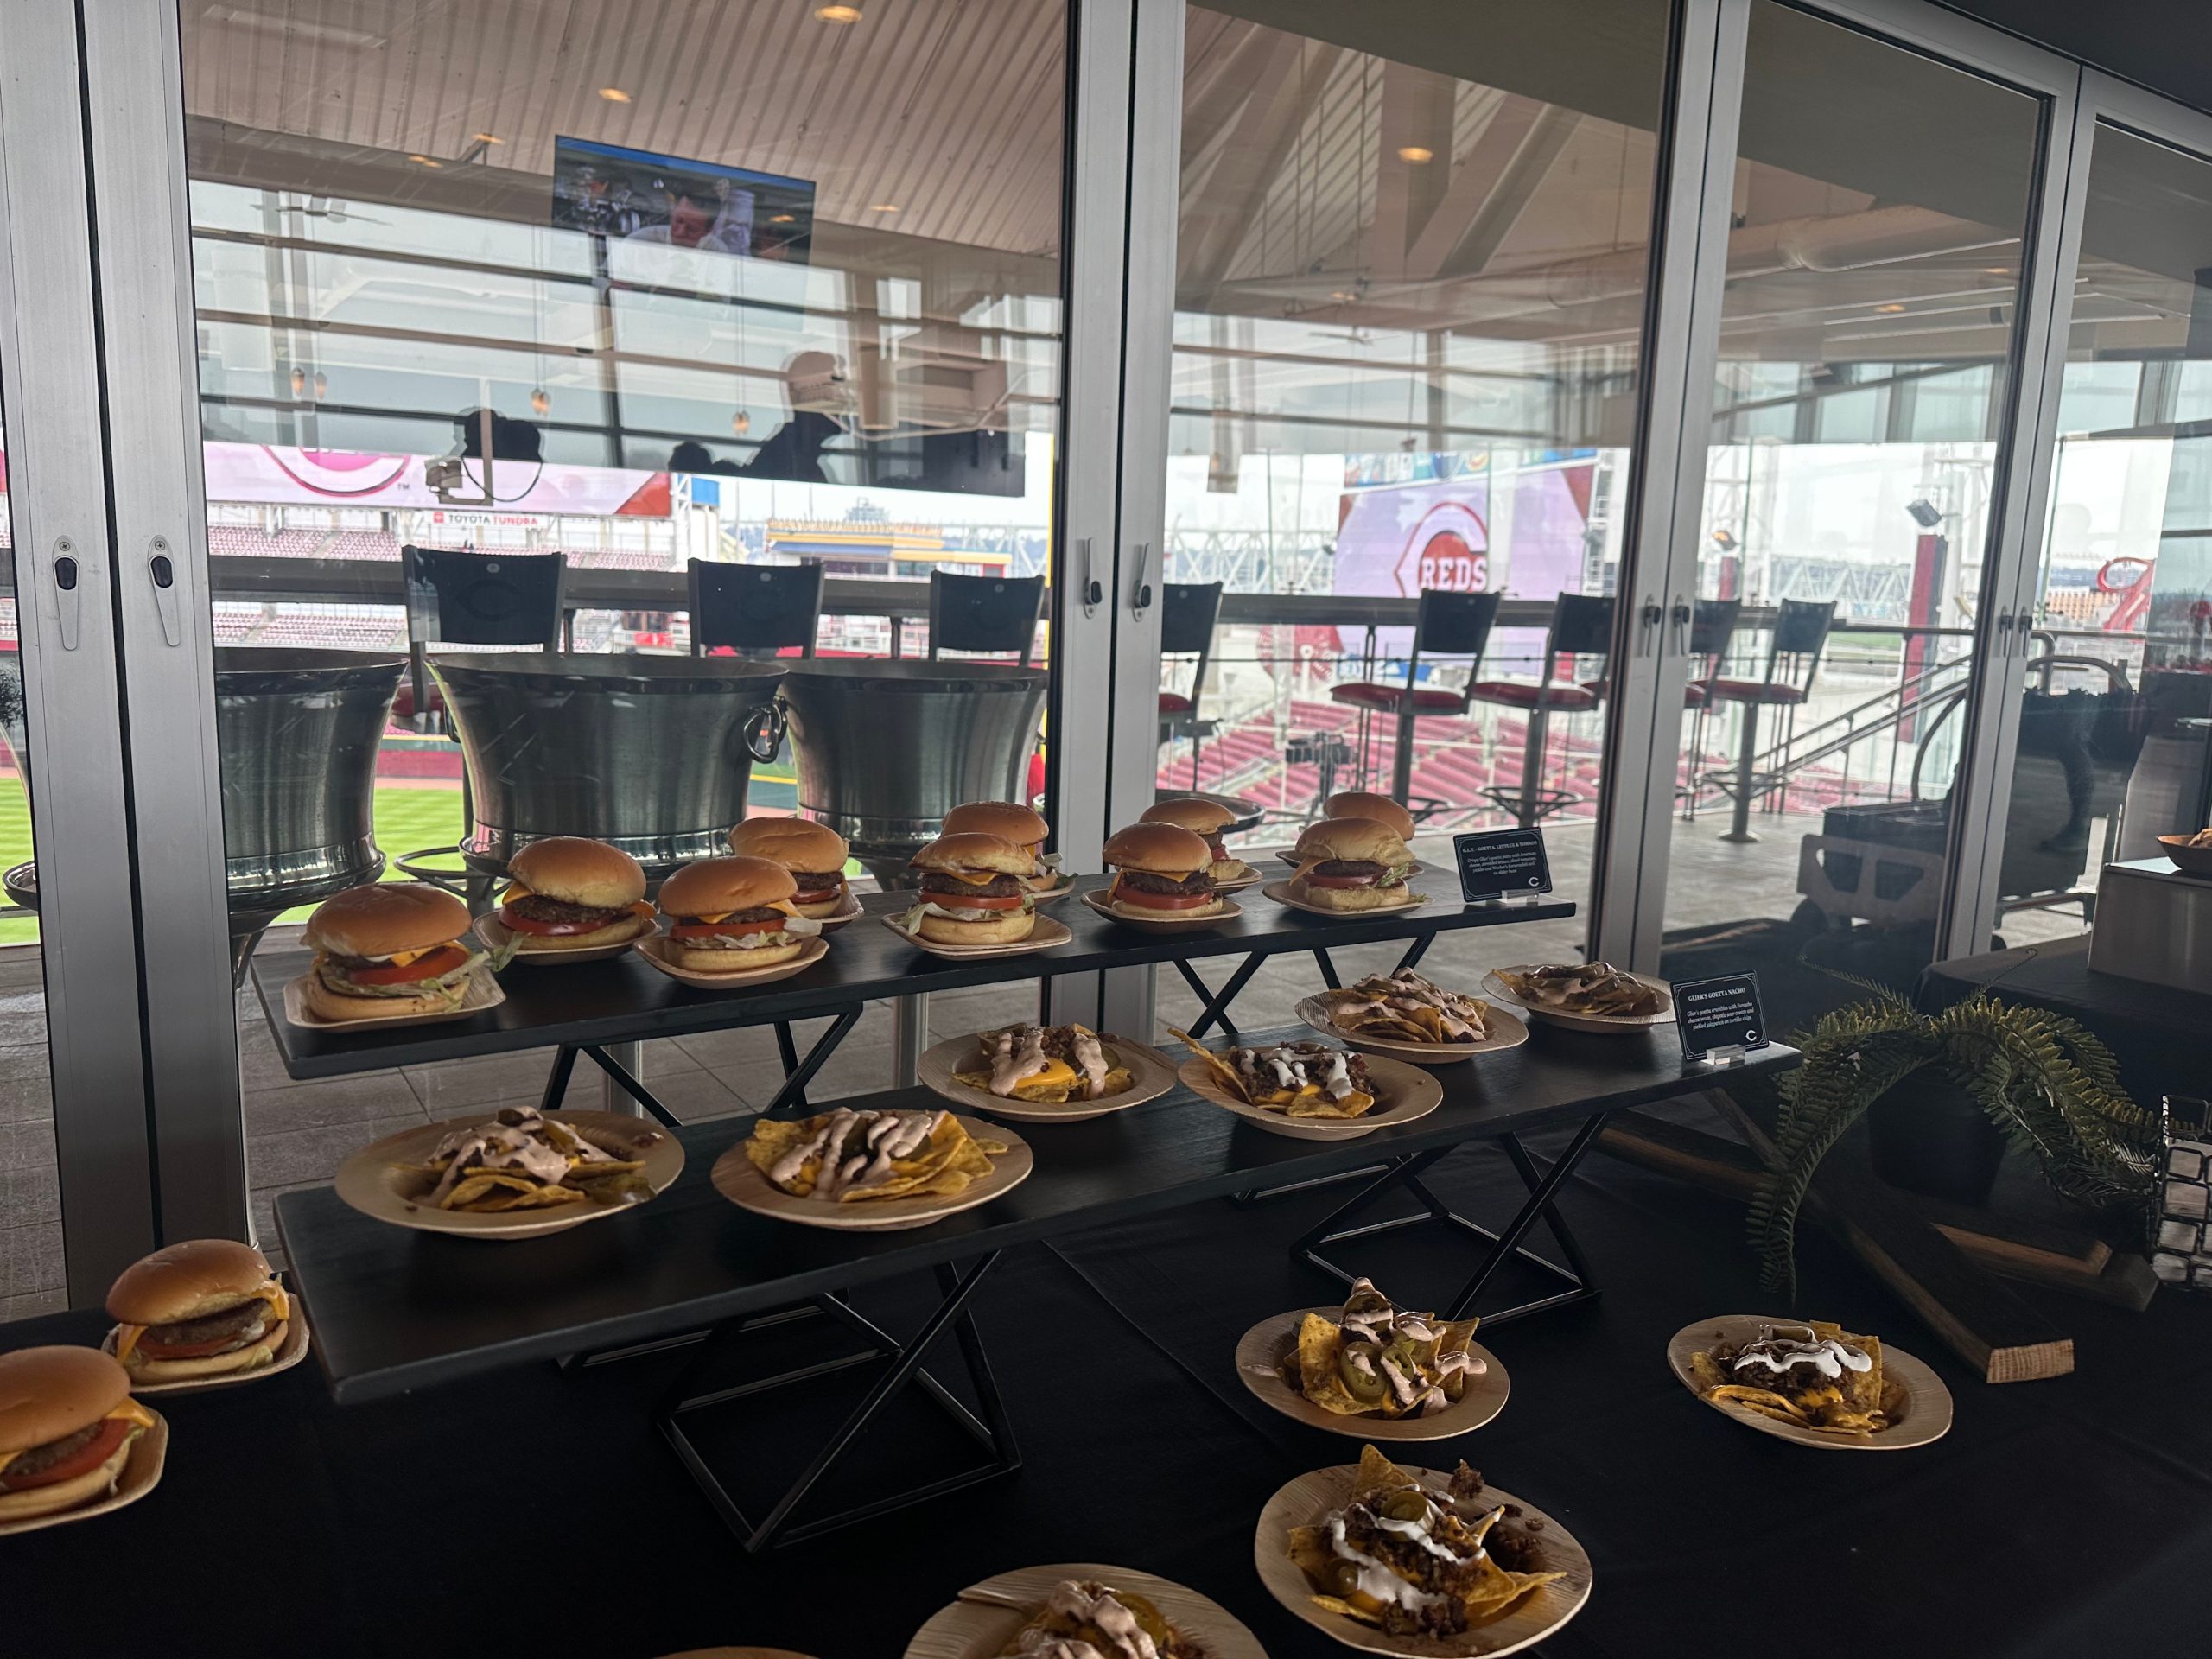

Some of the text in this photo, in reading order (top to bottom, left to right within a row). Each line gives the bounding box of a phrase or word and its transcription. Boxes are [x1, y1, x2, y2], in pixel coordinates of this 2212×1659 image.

[449, 514, 537, 526] TOYOTA TUNDRA
[1420, 556, 1488, 592] REDS
